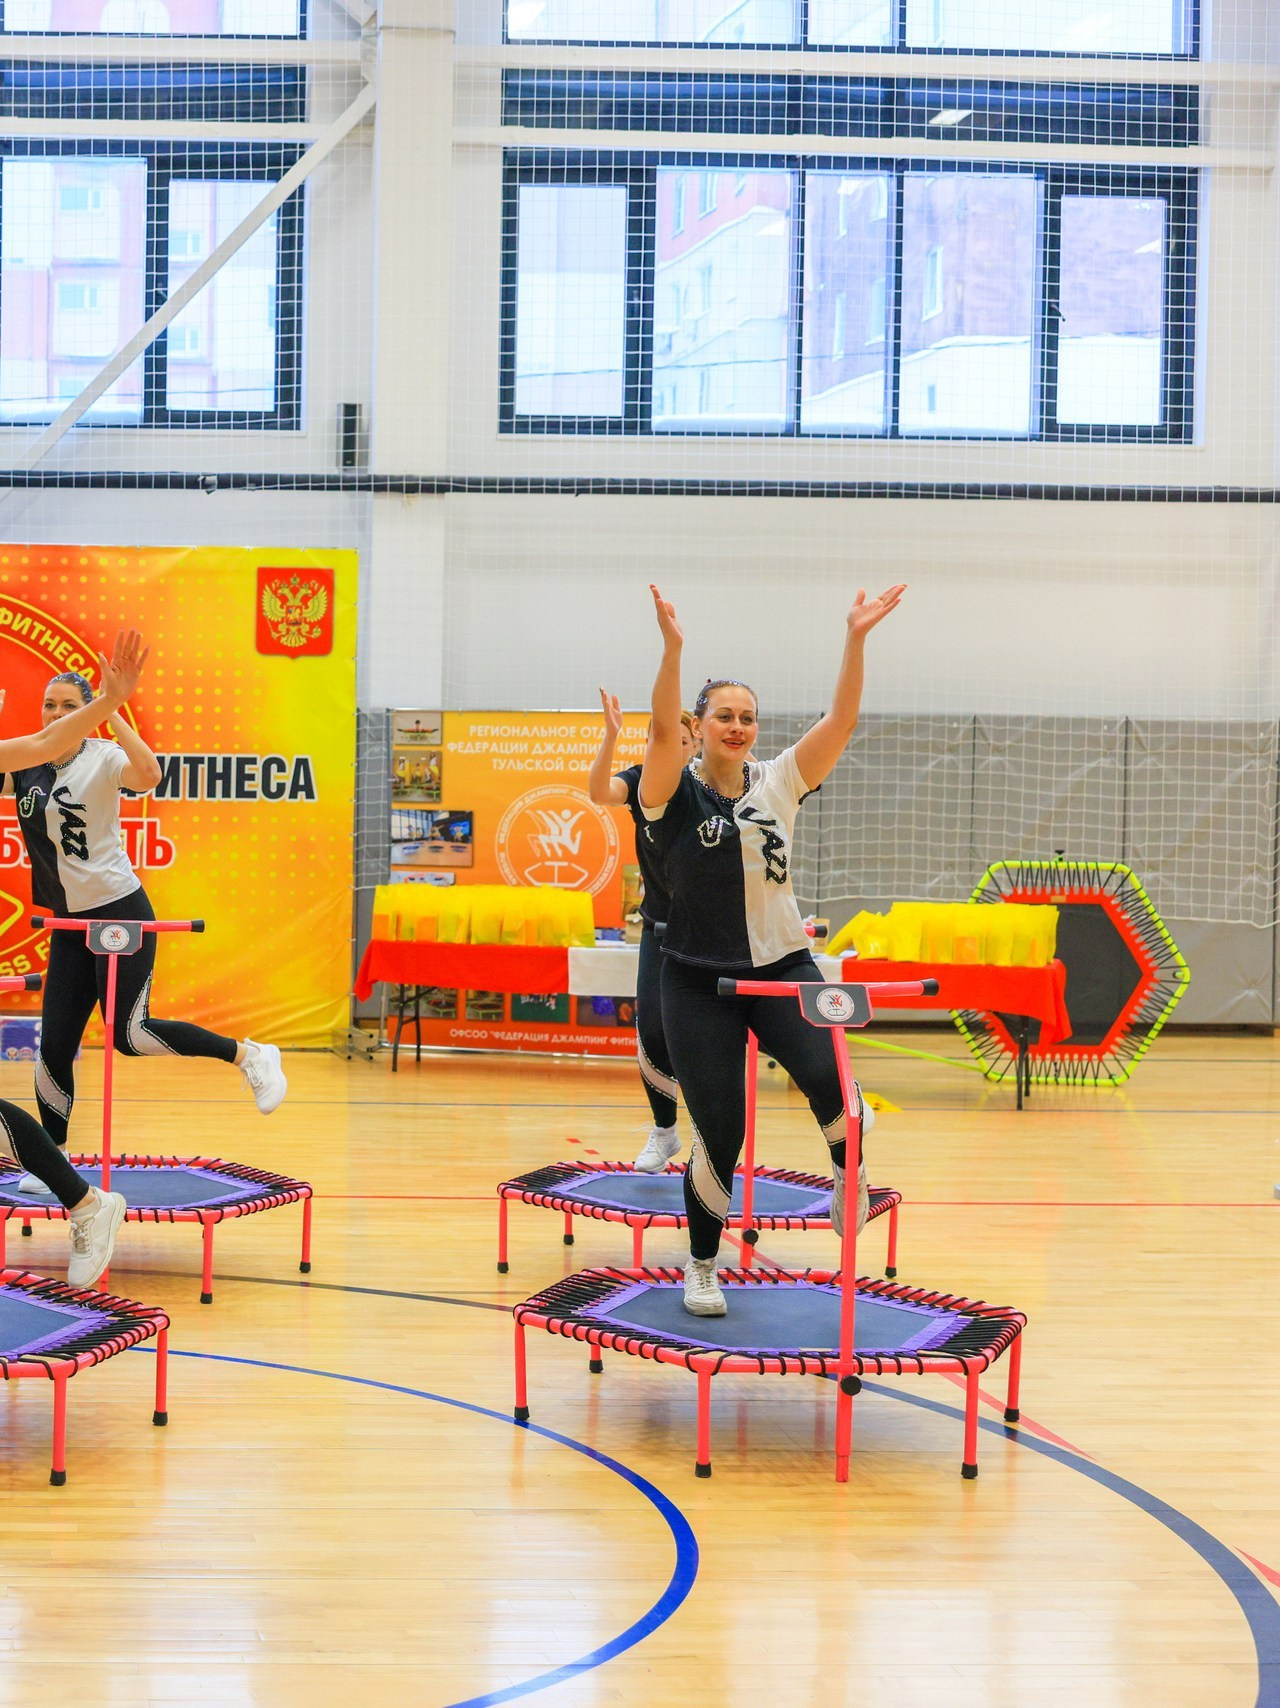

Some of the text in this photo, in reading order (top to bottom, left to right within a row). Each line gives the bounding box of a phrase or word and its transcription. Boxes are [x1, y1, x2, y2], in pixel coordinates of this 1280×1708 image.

[470, 725, 576, 738] РЕГИОНАЛЬНОЕ
[447, 742, 530, 755] ФЕДЕРАЦИИ
[492, 757, 564, 771] ТУЛЬСКОЙ
[123, 753, 319, 801] ИТНЕСА
[51, 786, 89, 861] JAZZ
[449, 1028, 488, 1039] ОФСОО
[551, 1034, 608, 1045] ДЖАМПИНГ
